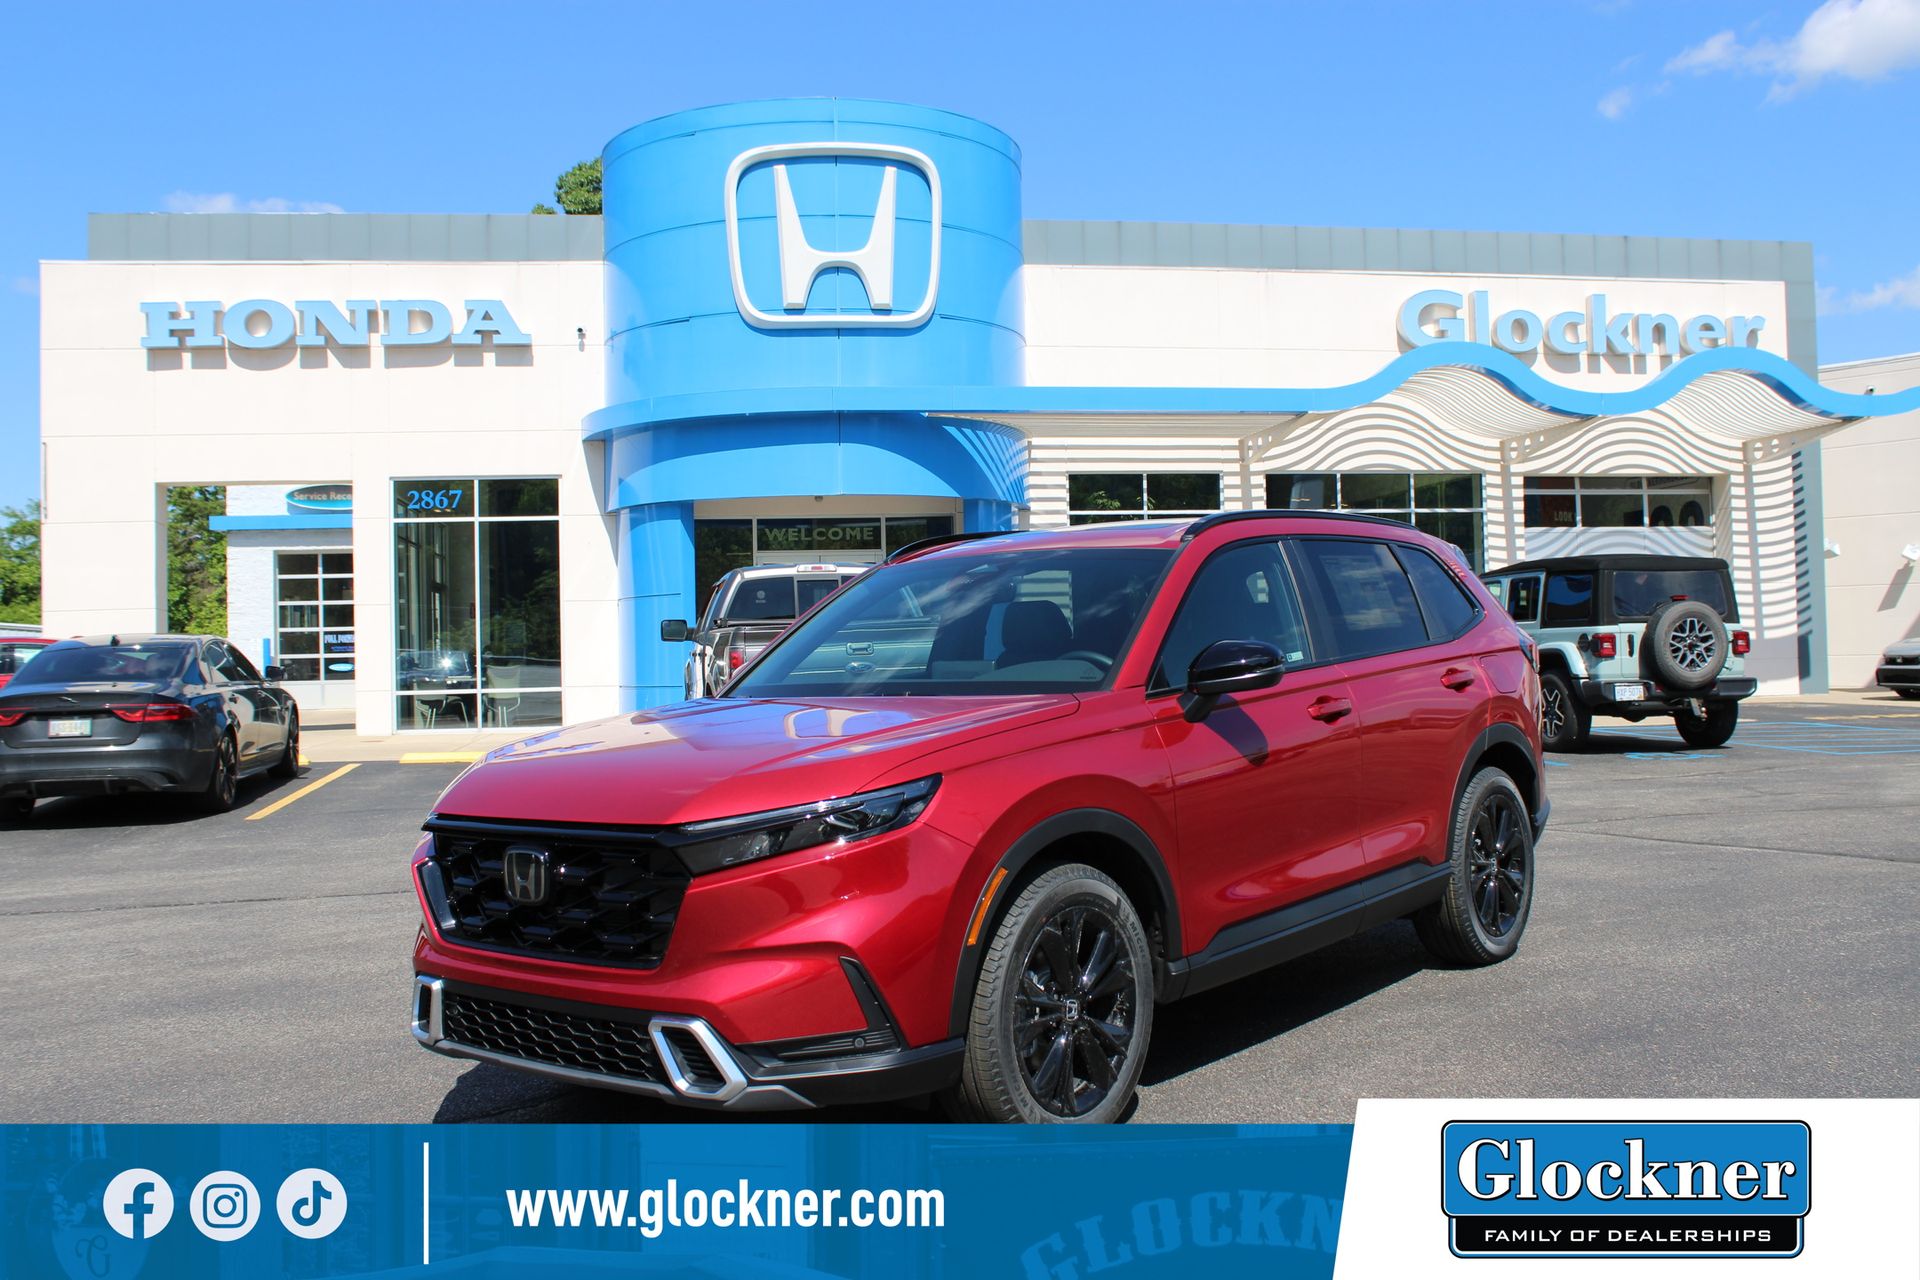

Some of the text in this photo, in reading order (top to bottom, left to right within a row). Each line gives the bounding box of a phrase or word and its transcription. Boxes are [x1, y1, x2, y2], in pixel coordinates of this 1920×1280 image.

[140, 299, 532, 348] HONDA
[1395, 289, 1766, 356] Glockner
[293, 491, 328, 501] Service
[407, 489, 463, 510] 2867
[764, 526, 875, 541] WELCOME
